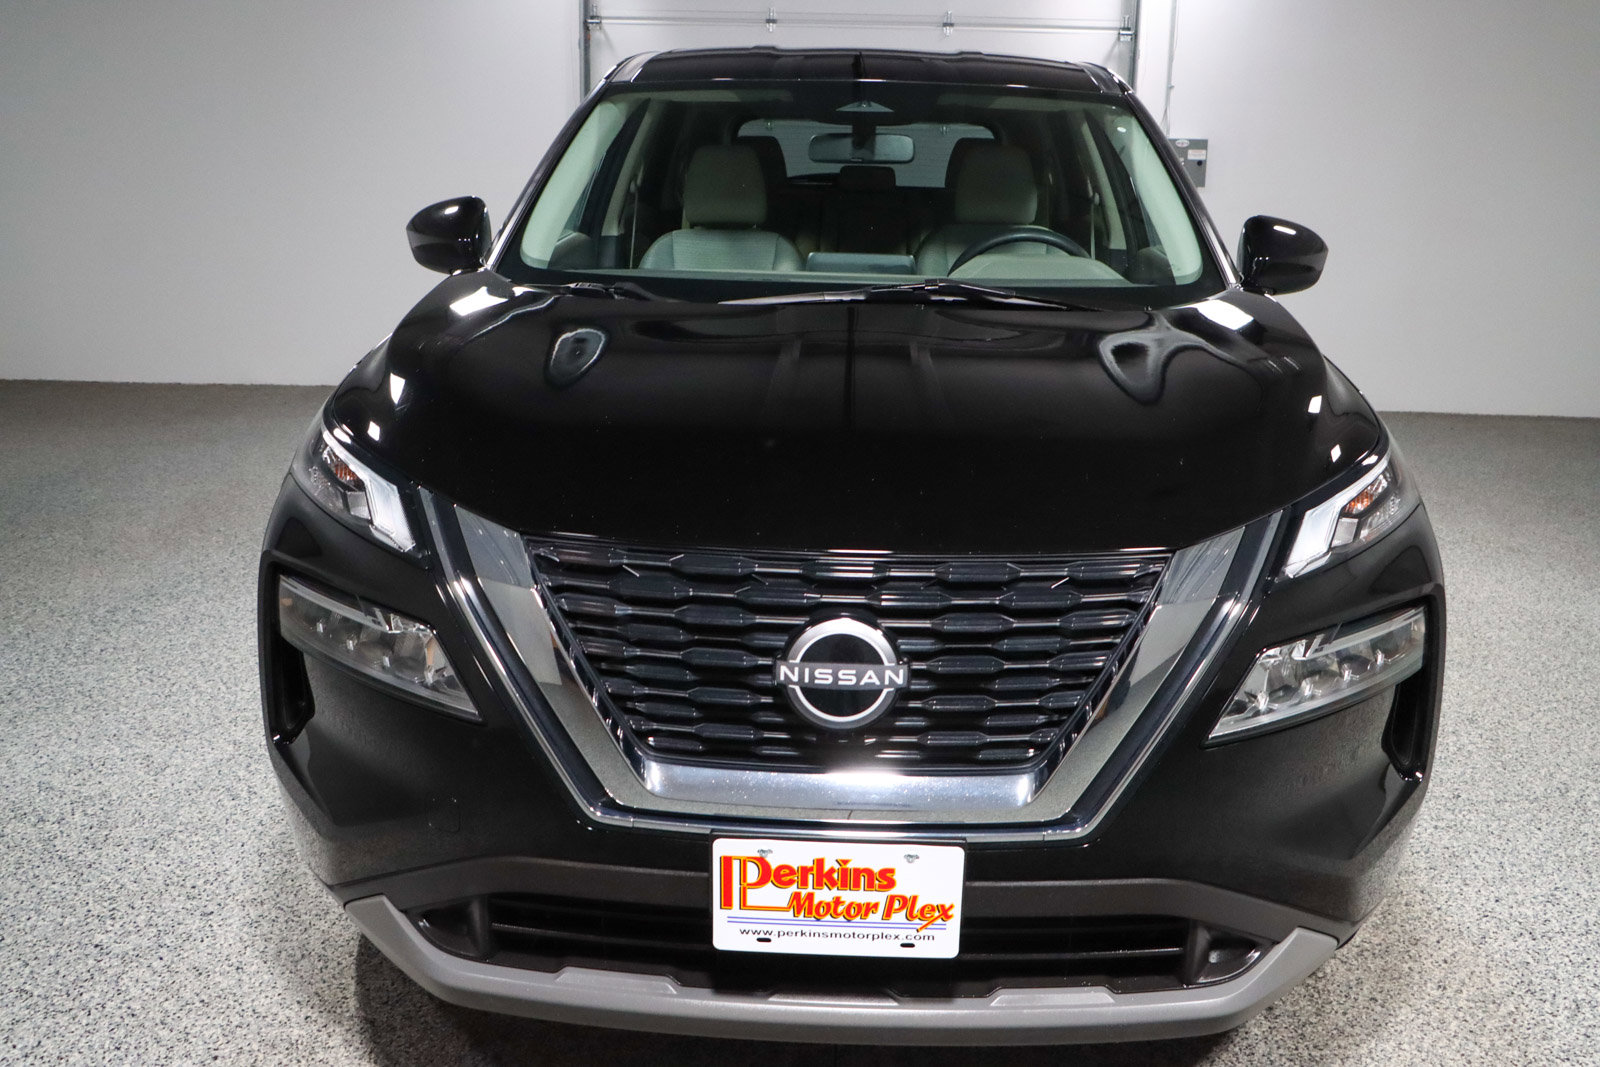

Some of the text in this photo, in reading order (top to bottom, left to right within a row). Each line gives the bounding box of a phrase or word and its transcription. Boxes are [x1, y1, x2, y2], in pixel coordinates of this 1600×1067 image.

[780, 665, 904, 686] NISSAN
[720, 855, 897, 910] Perkins
[789, 891, 955, 932] Motor Plex
[739, 927, 936, 942] www.perkinsmotorplex.com
